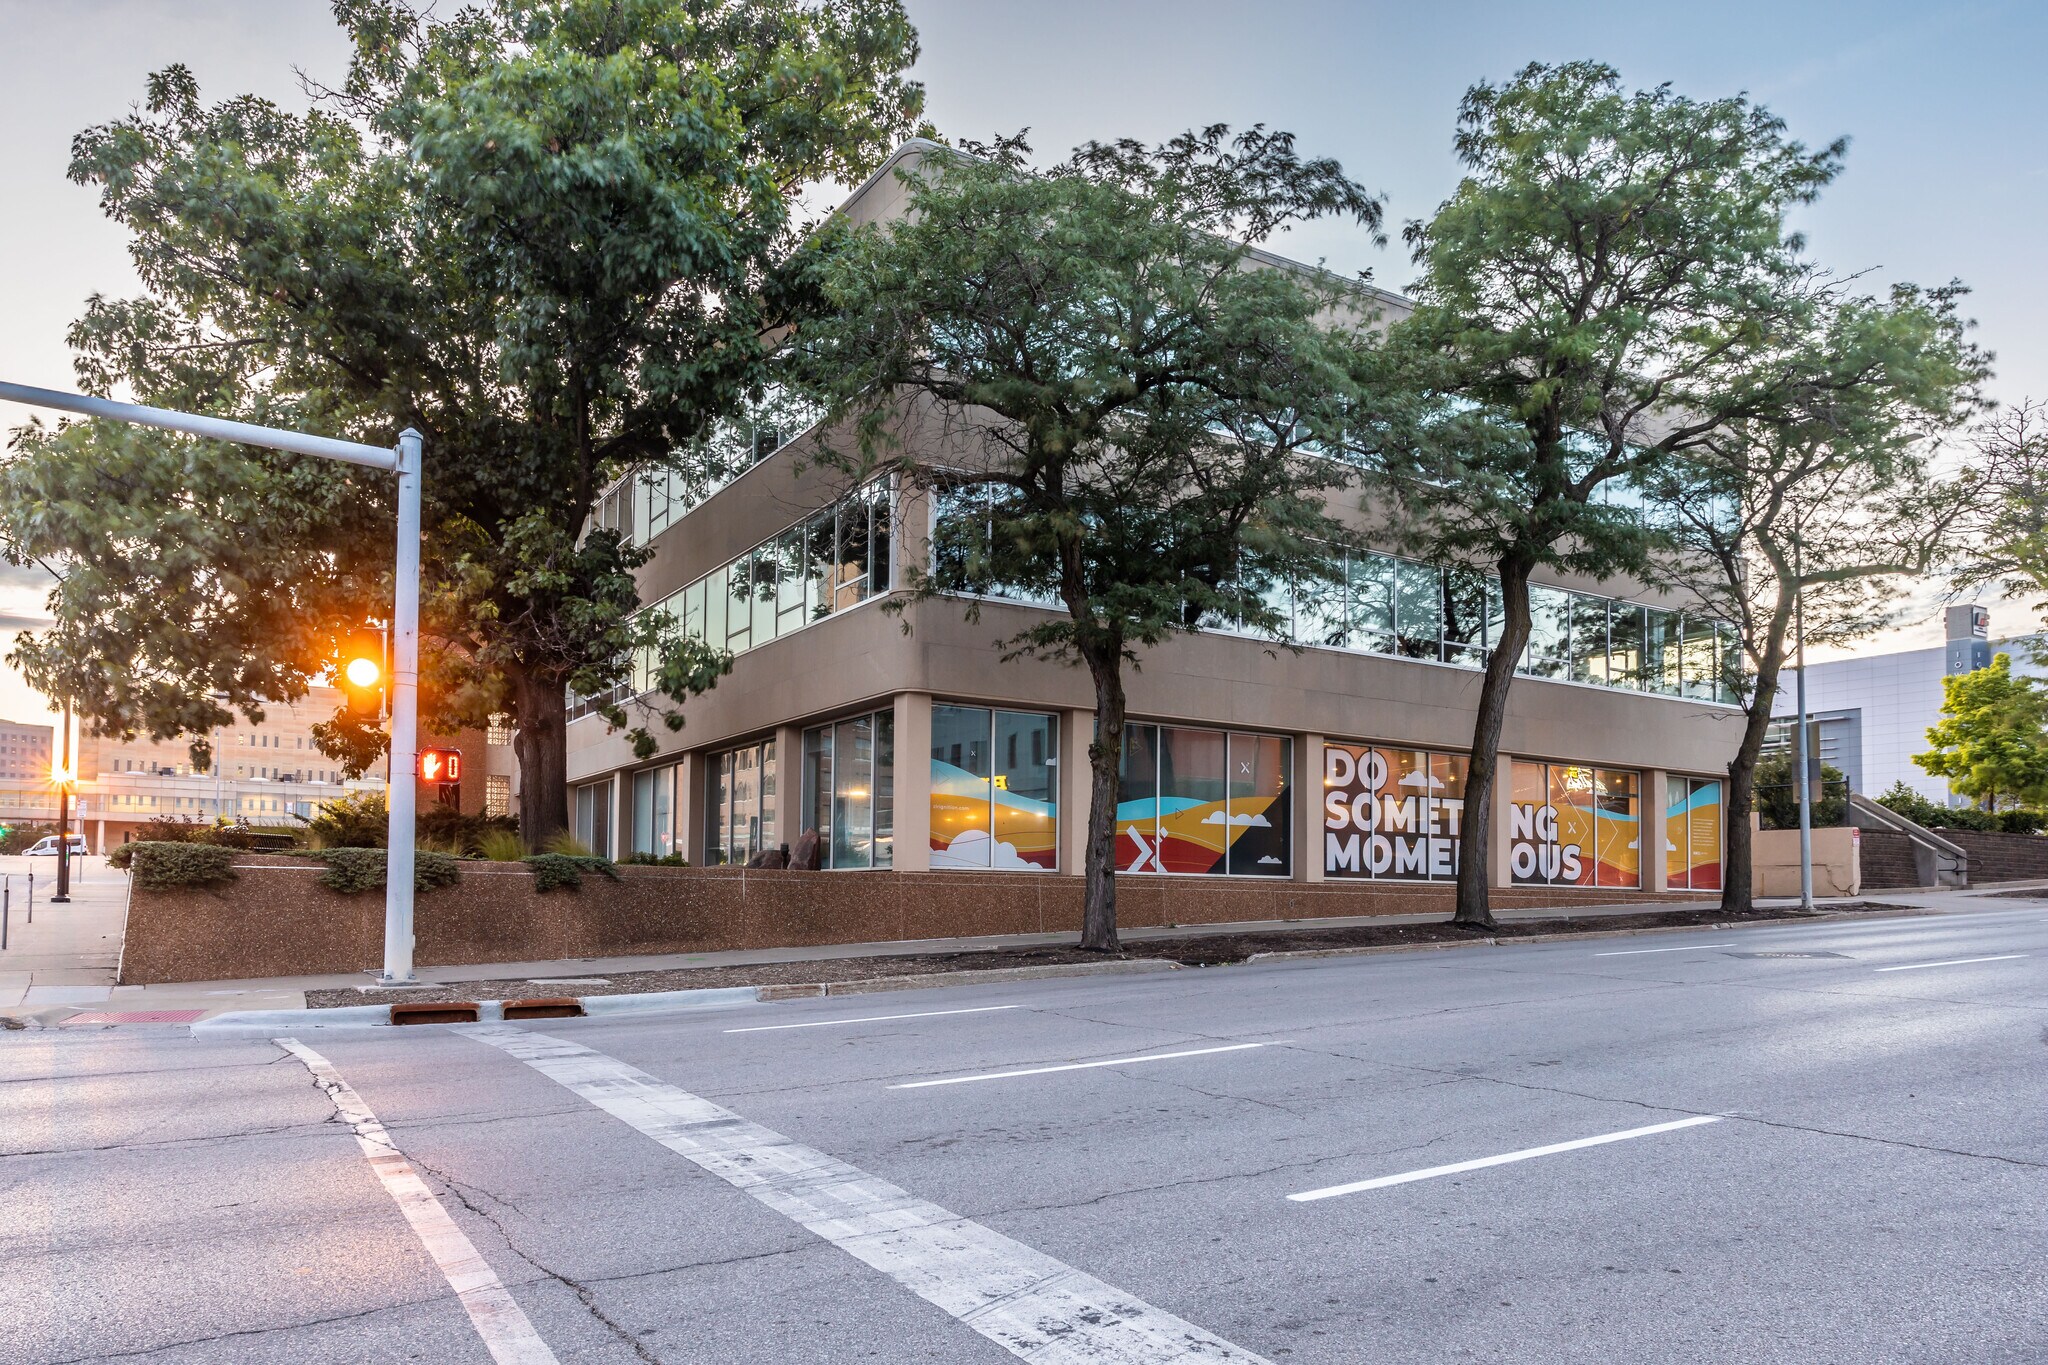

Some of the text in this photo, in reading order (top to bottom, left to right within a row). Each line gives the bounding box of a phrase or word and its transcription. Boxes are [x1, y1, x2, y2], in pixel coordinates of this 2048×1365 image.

[1327, 748, 1388, 790] DO
[1326, 791, 1558, 842] SOMETNG
[1326, 833, 1582, 880] MOMEOUS
